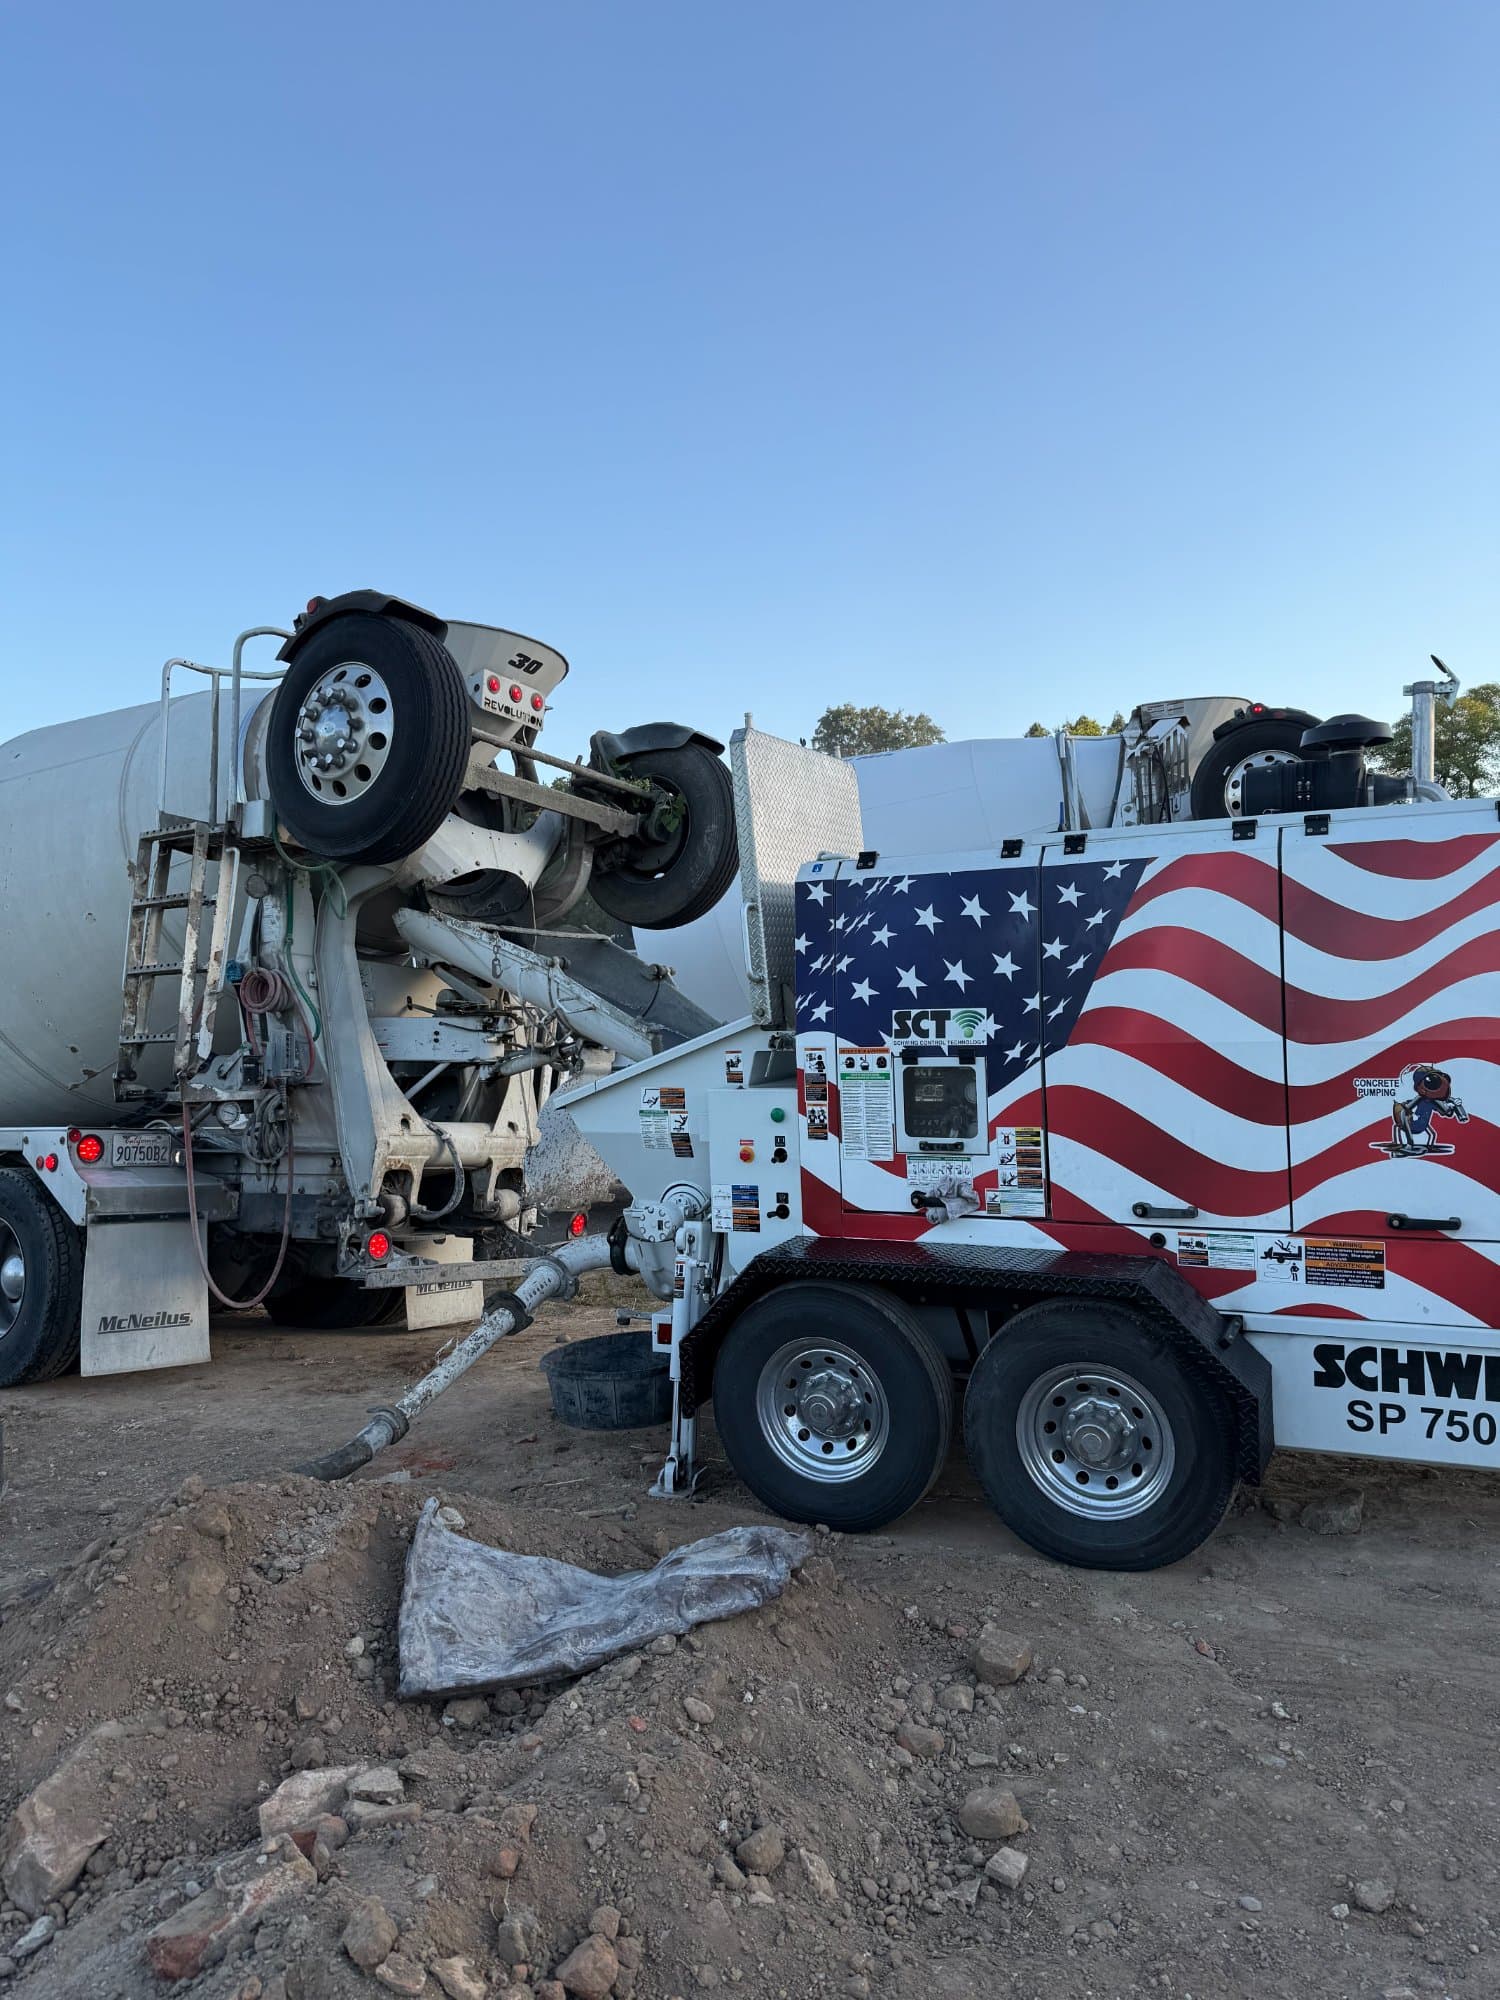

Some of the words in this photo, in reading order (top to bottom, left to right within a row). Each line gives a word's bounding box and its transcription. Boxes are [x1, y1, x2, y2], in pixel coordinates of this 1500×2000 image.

[508, 653, 543, 675] 30
[484, 697, 543, 727] REVOLUTION
[894, 1010, 951, 1039] SCT
[1354, 1079, 1399, 1088] CONCRETE
[1358, 1088, 1396, 1097] PUMPING
[116, 1145, 168, 1161] 90750B2
[98, 1311, 191, 1331] McNeilus
[1347, 1400, 1406, 1434] SP
[1420, 1407, 1497, 1446] 750
